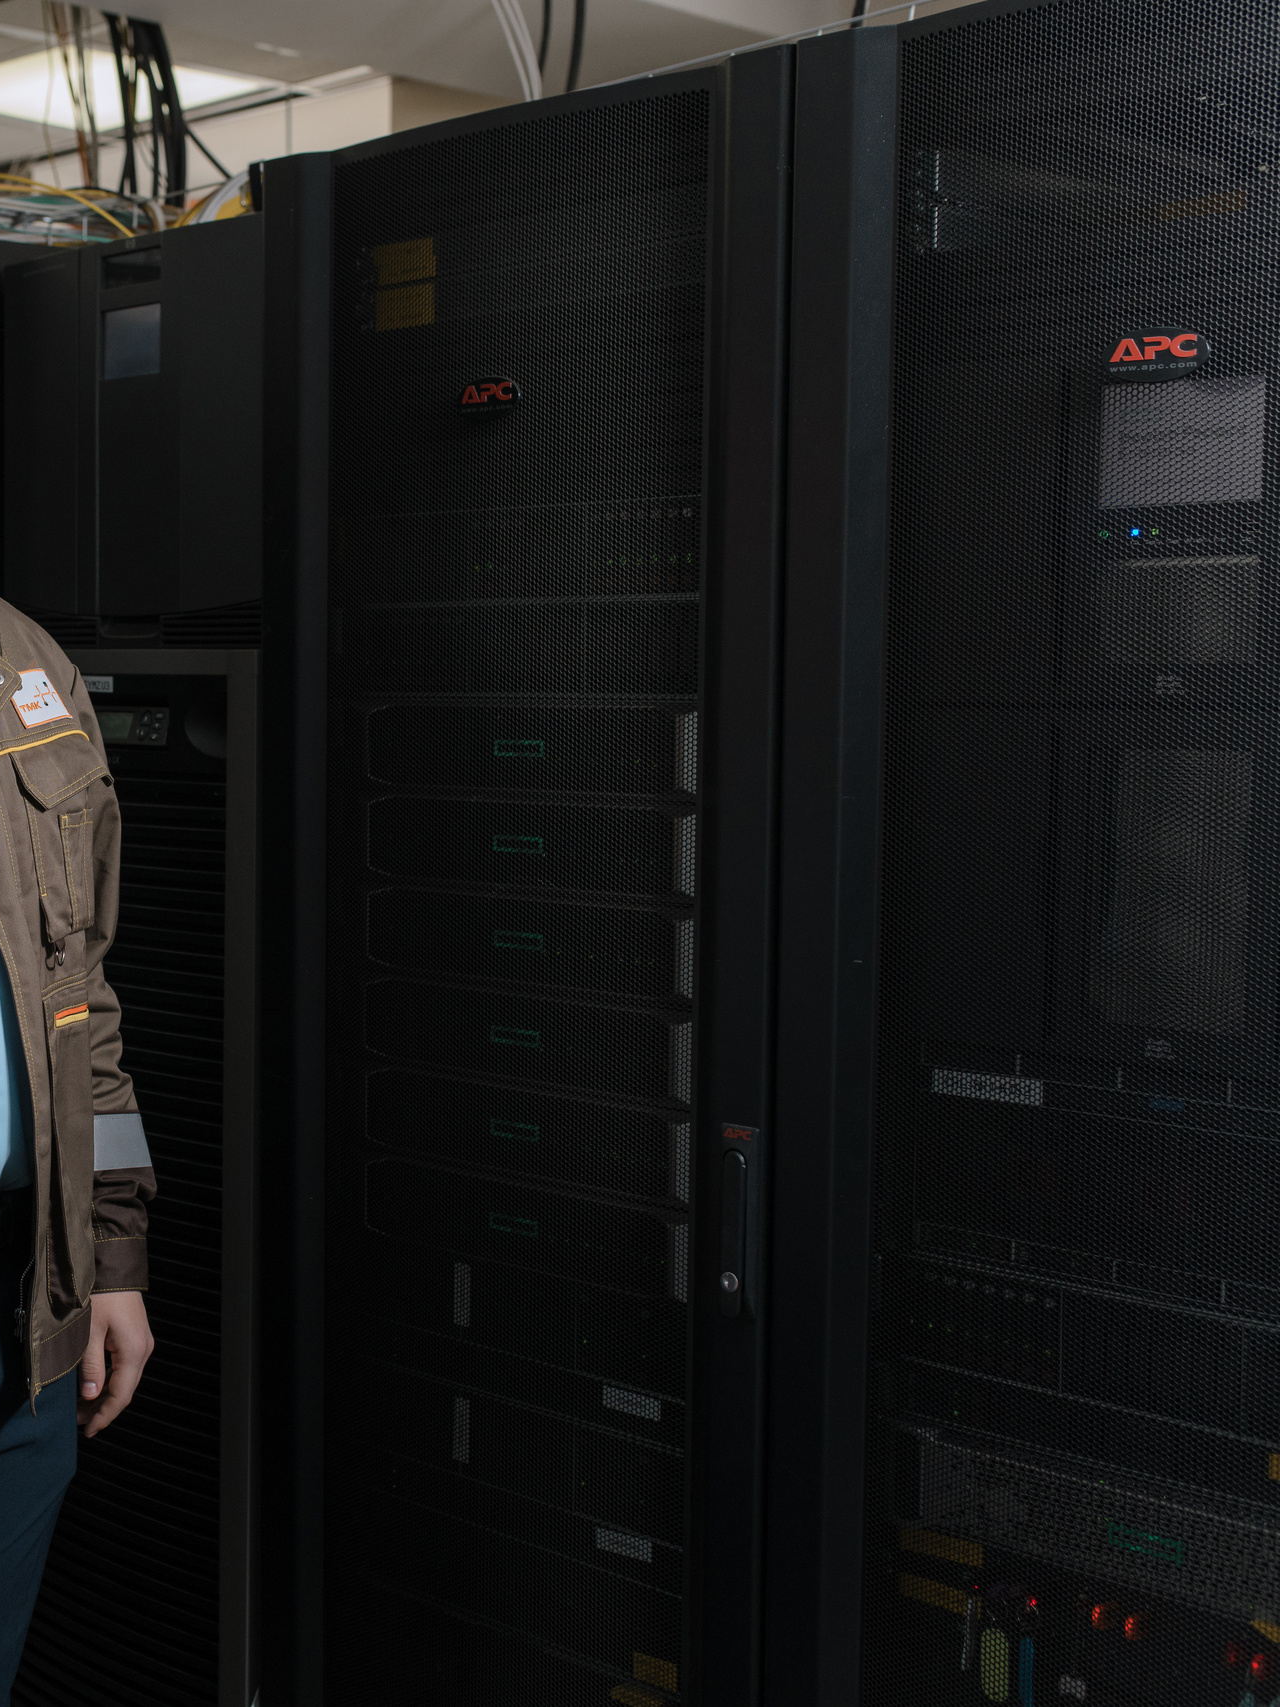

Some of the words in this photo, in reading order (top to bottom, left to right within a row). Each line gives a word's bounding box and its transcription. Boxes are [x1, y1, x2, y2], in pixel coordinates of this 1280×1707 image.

[1109, 334, 1197, 363] APC
[1109, 361, 1198, 373] www.apc.com
[461, 381, 512, 405] APC
[723, 1127, 752, 1141] APC
